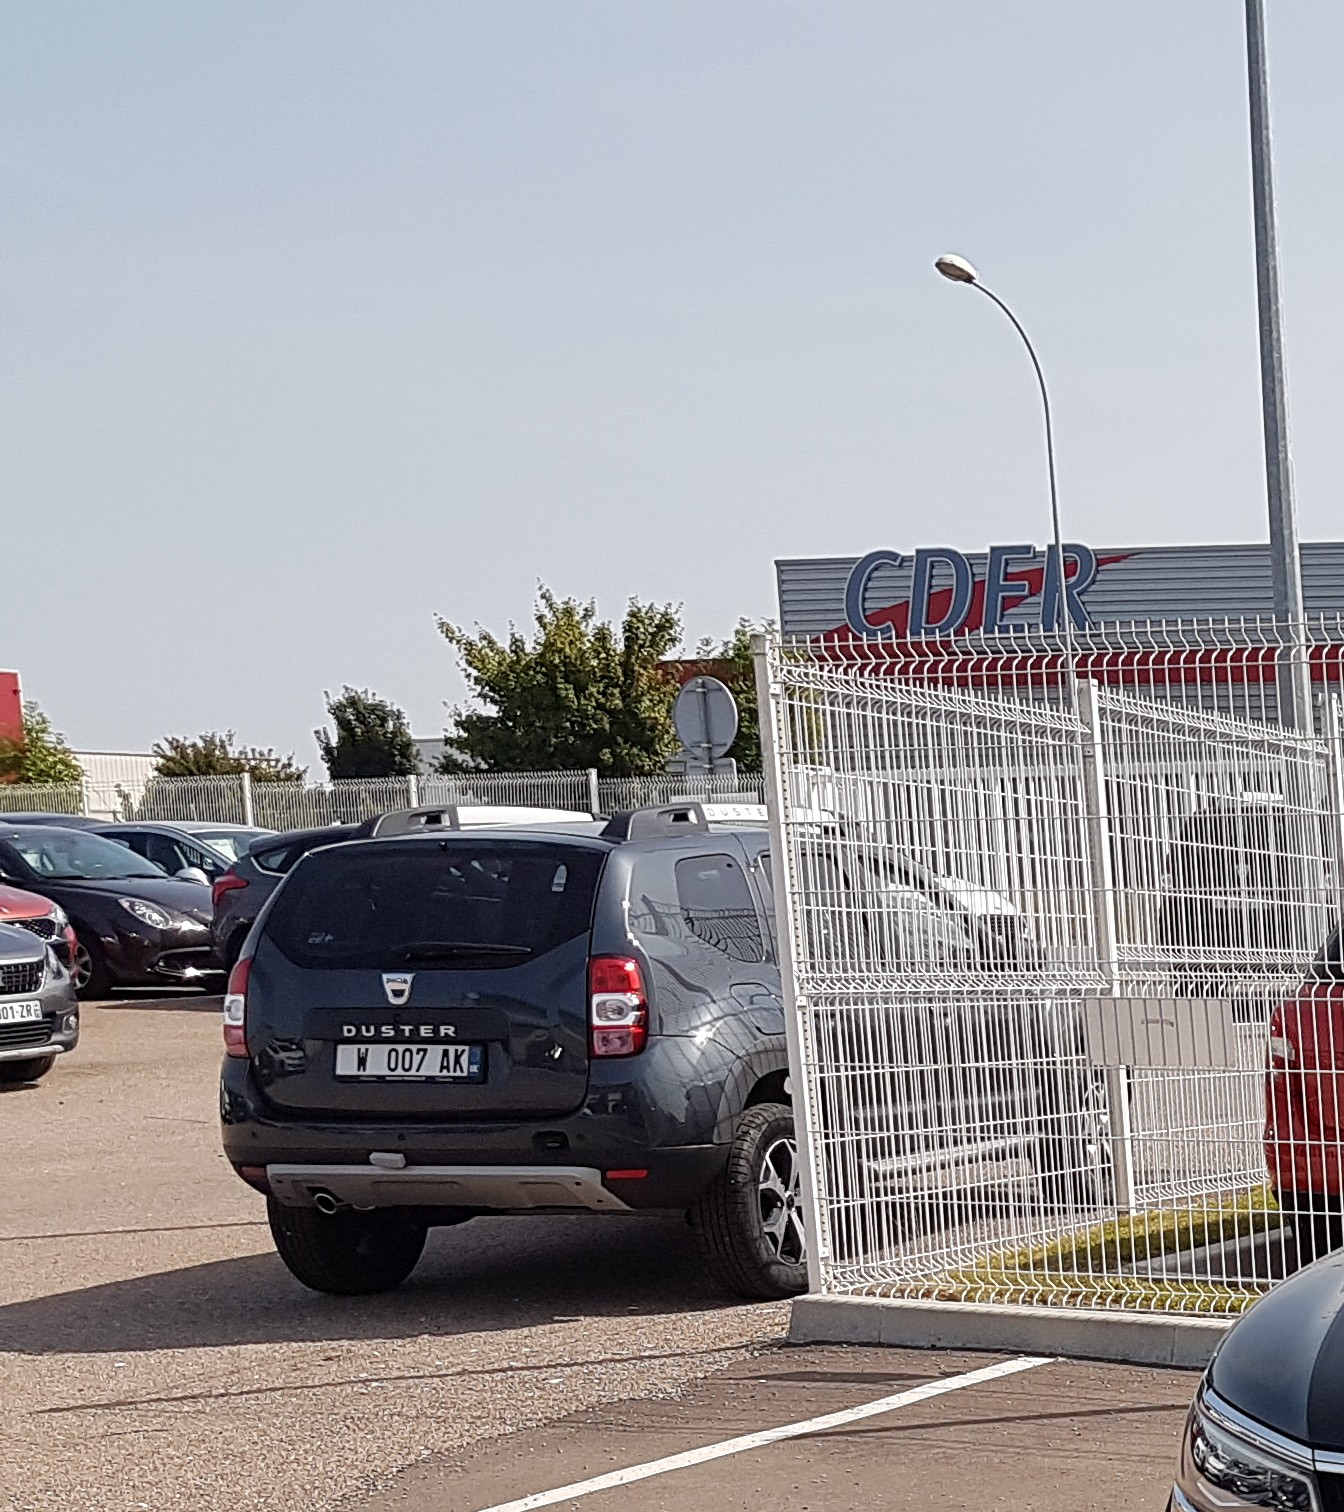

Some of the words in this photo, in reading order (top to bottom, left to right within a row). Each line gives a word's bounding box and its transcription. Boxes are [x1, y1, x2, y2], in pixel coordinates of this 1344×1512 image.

[844, 543, 1098, 639] CDER
[705, 807, 767, 817] DUSTE
[342, 1025, 457, 1037] DUSTER
[356, 1047, 369, 1073] W
[387, 1048, 429, 1073] 007
[439, 1048, 466, 1074] AK
